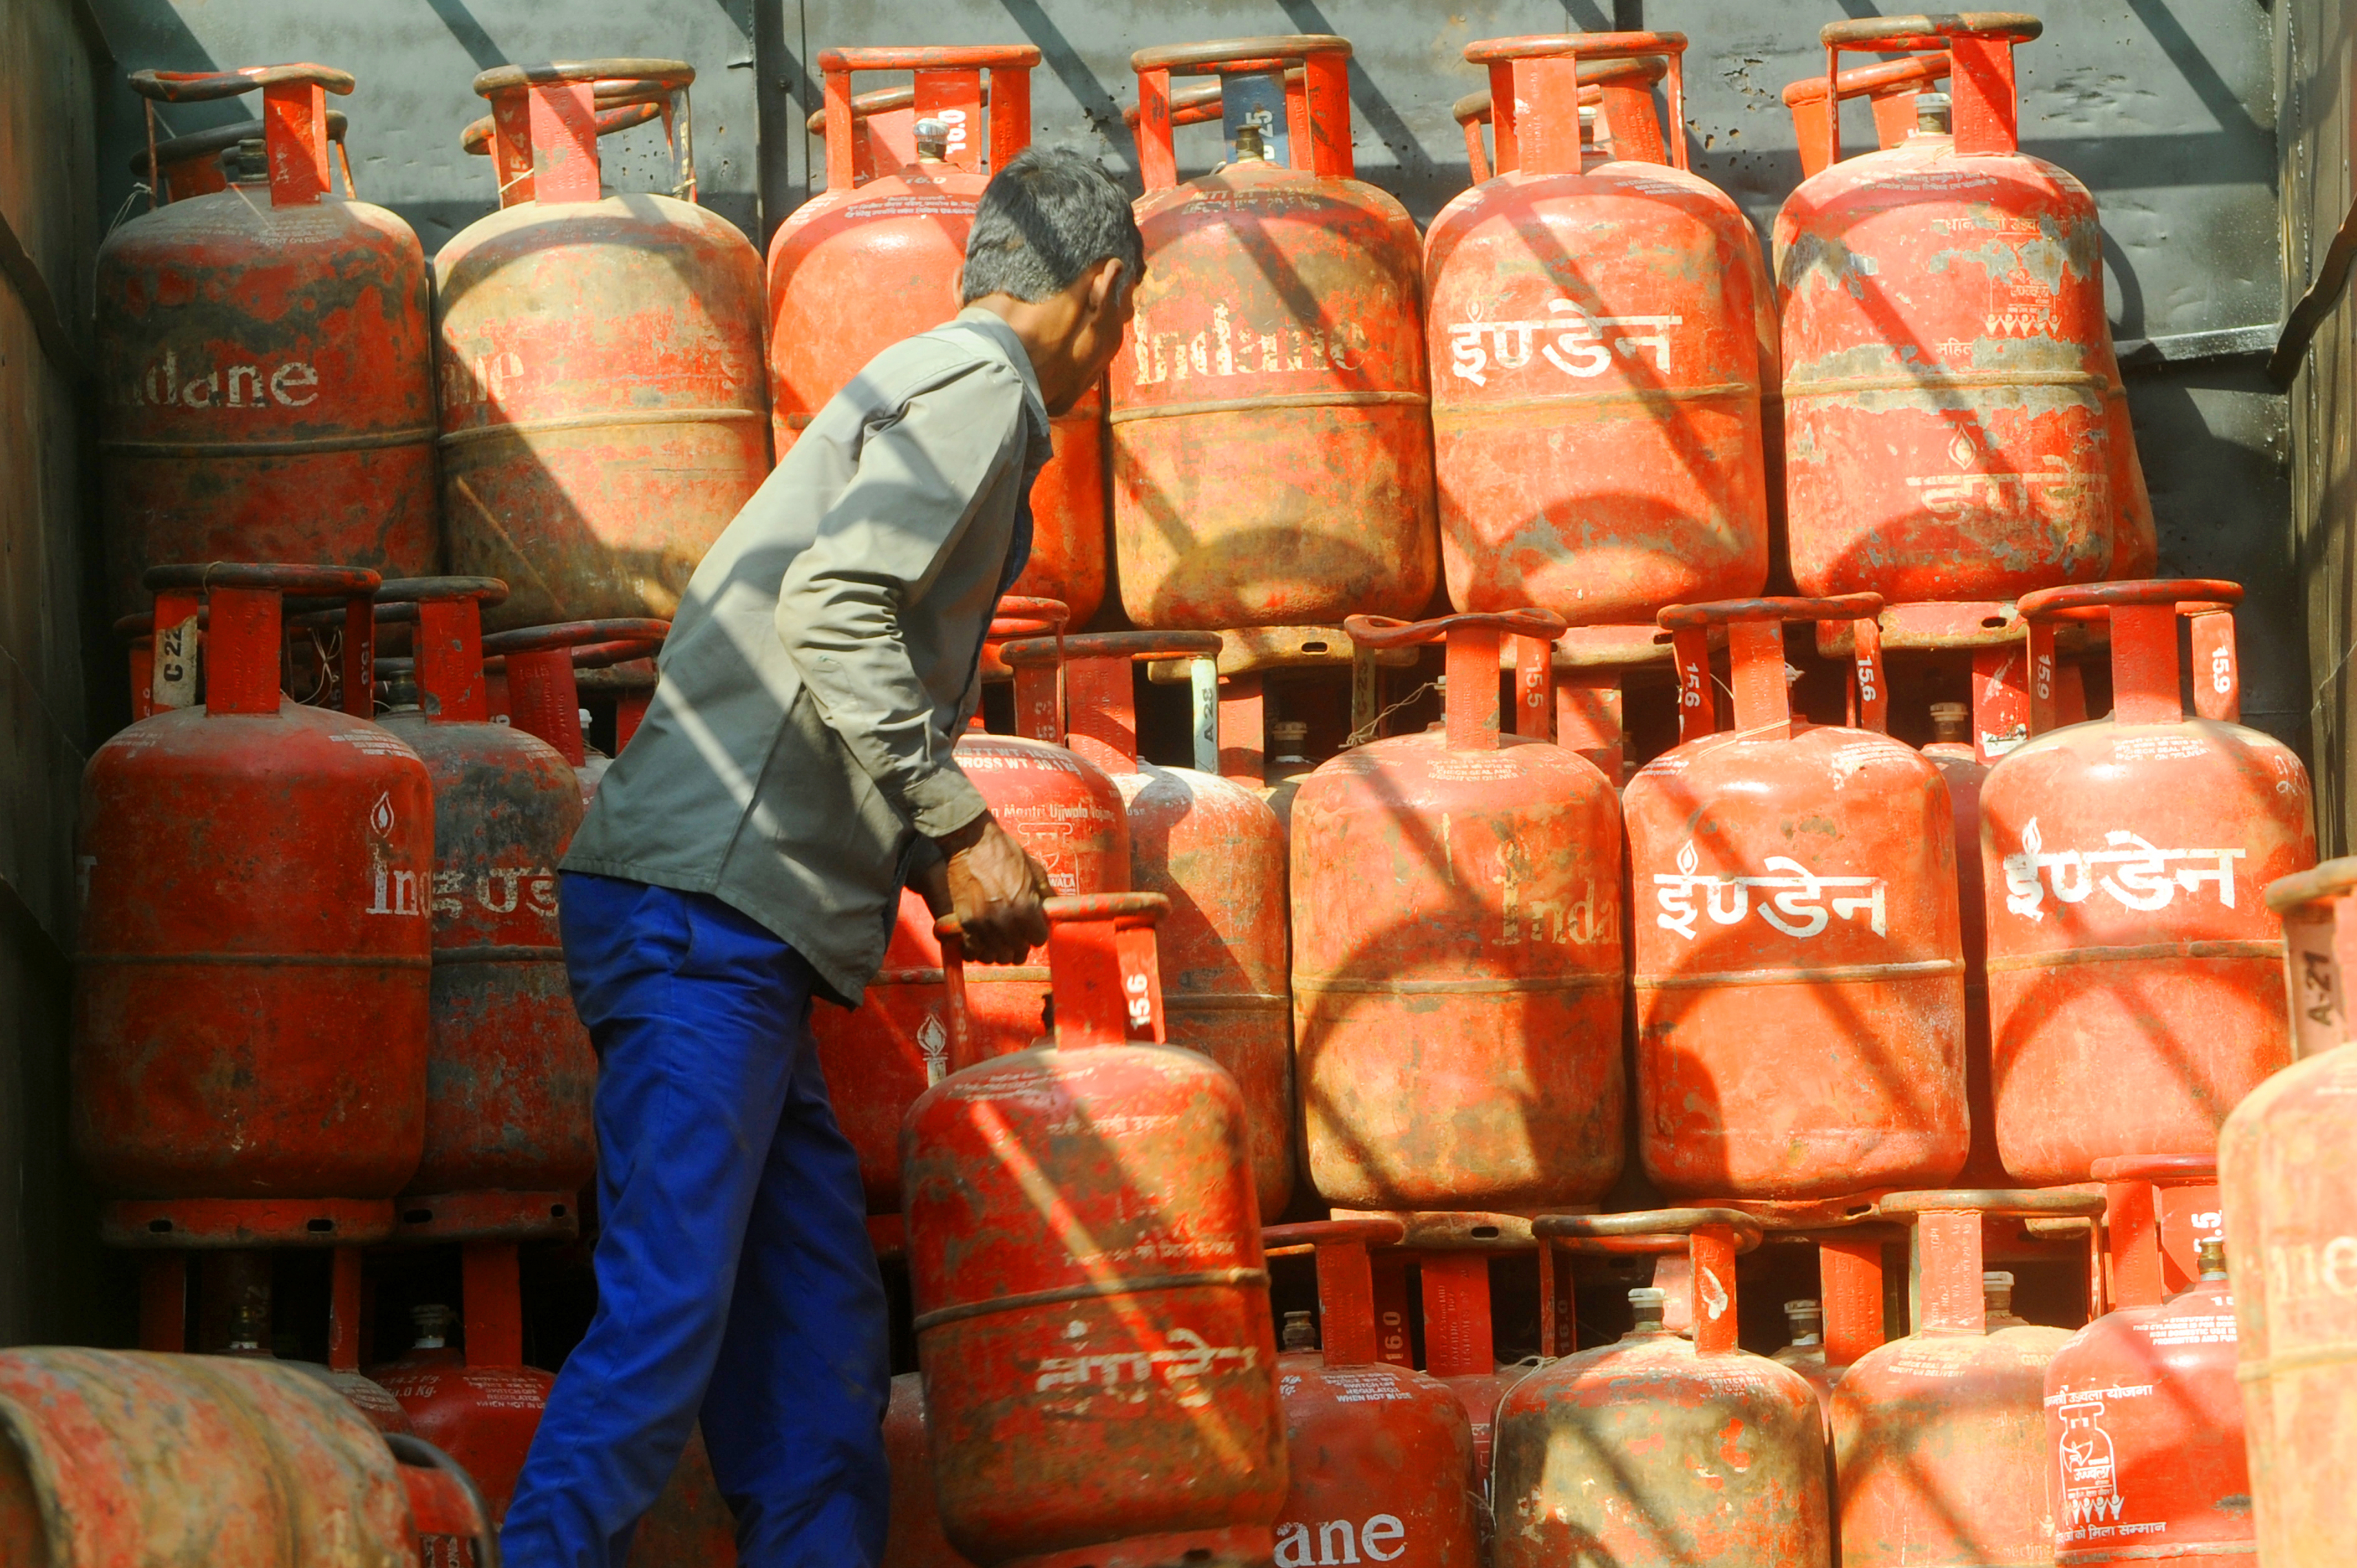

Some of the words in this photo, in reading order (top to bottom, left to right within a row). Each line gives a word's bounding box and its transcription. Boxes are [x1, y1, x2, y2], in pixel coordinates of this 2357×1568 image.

[1684, 662, 1701, 708] 15.6
[1857, 655, 1877, 702] 15.6
[2036, 654, 2051, 699] 15.9
[2210, 645, 2231, 694] 15.9
[953, 756, 1003, 768] GROSS
[1004, 757, 1028, 769] WT
[1033, 759, 1064, 772] 30.1
[1003, 804, 1046, 818] Mantri
[1049, 802, 1089, 822] Ujjwala
[1653, 855, 1888, 941] इण्डेन
[1382, 1311, 1404, 1362] 16.0
[1336, 1394, 1366, 1403] WHEN
[2106, 1384, 2154, 1399] योजना
[2088, 1524, 2116, 1541] मिला
